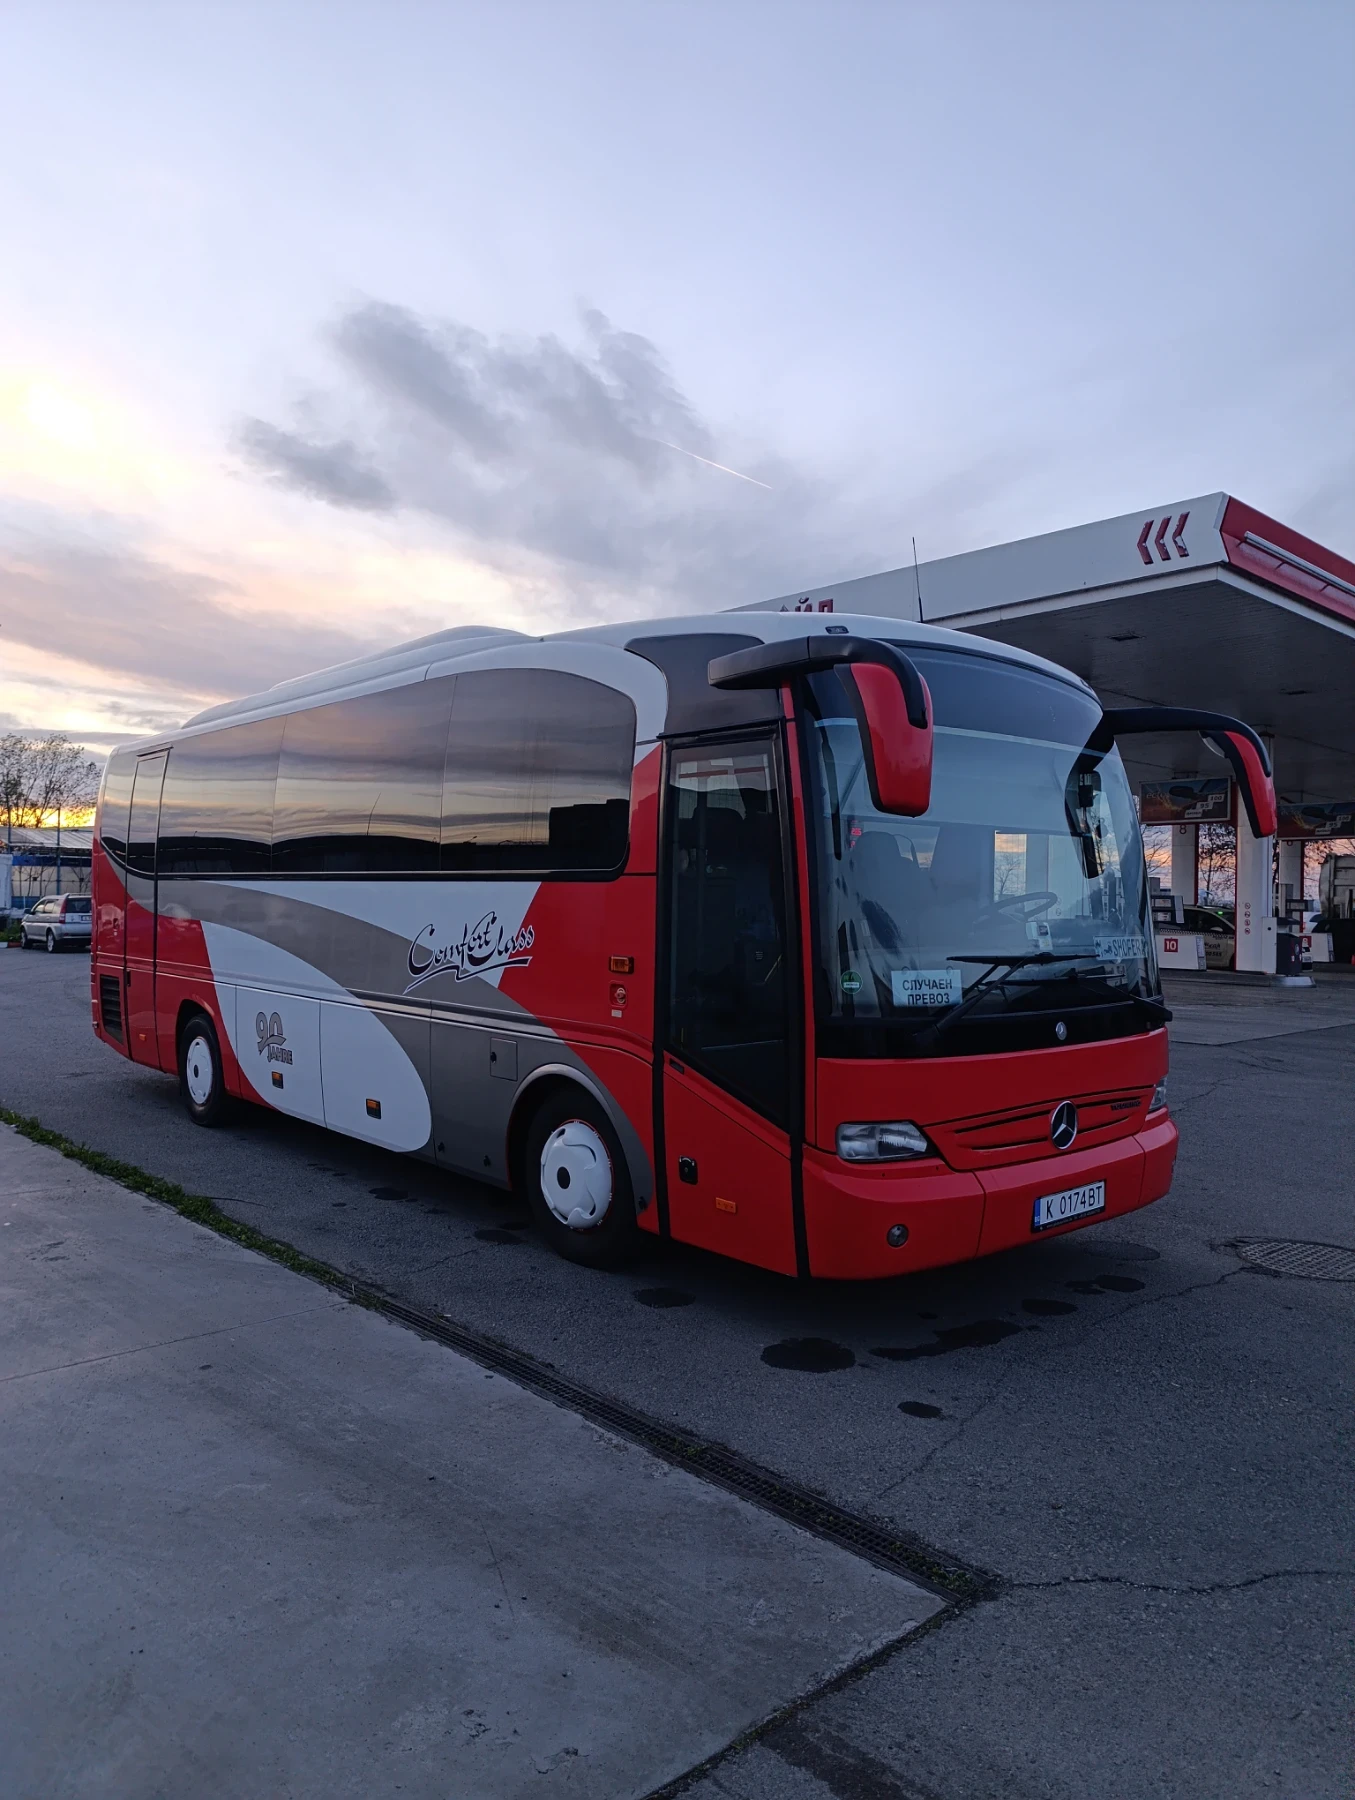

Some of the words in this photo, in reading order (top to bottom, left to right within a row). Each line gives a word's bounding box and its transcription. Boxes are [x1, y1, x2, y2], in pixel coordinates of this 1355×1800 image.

[407, 921, 491, 976] Comfort
[467, 911, 535, 967] Class
[1166, 941, 1176, 950] 10
[902, 978, 953, 991] СЛУЧАЕН
[908, 993, 950, 1005] ПРЕВОЗ
[267, 1044, 293, 1065] JAHRE
[1046, 1199, 1053, 1219] K
